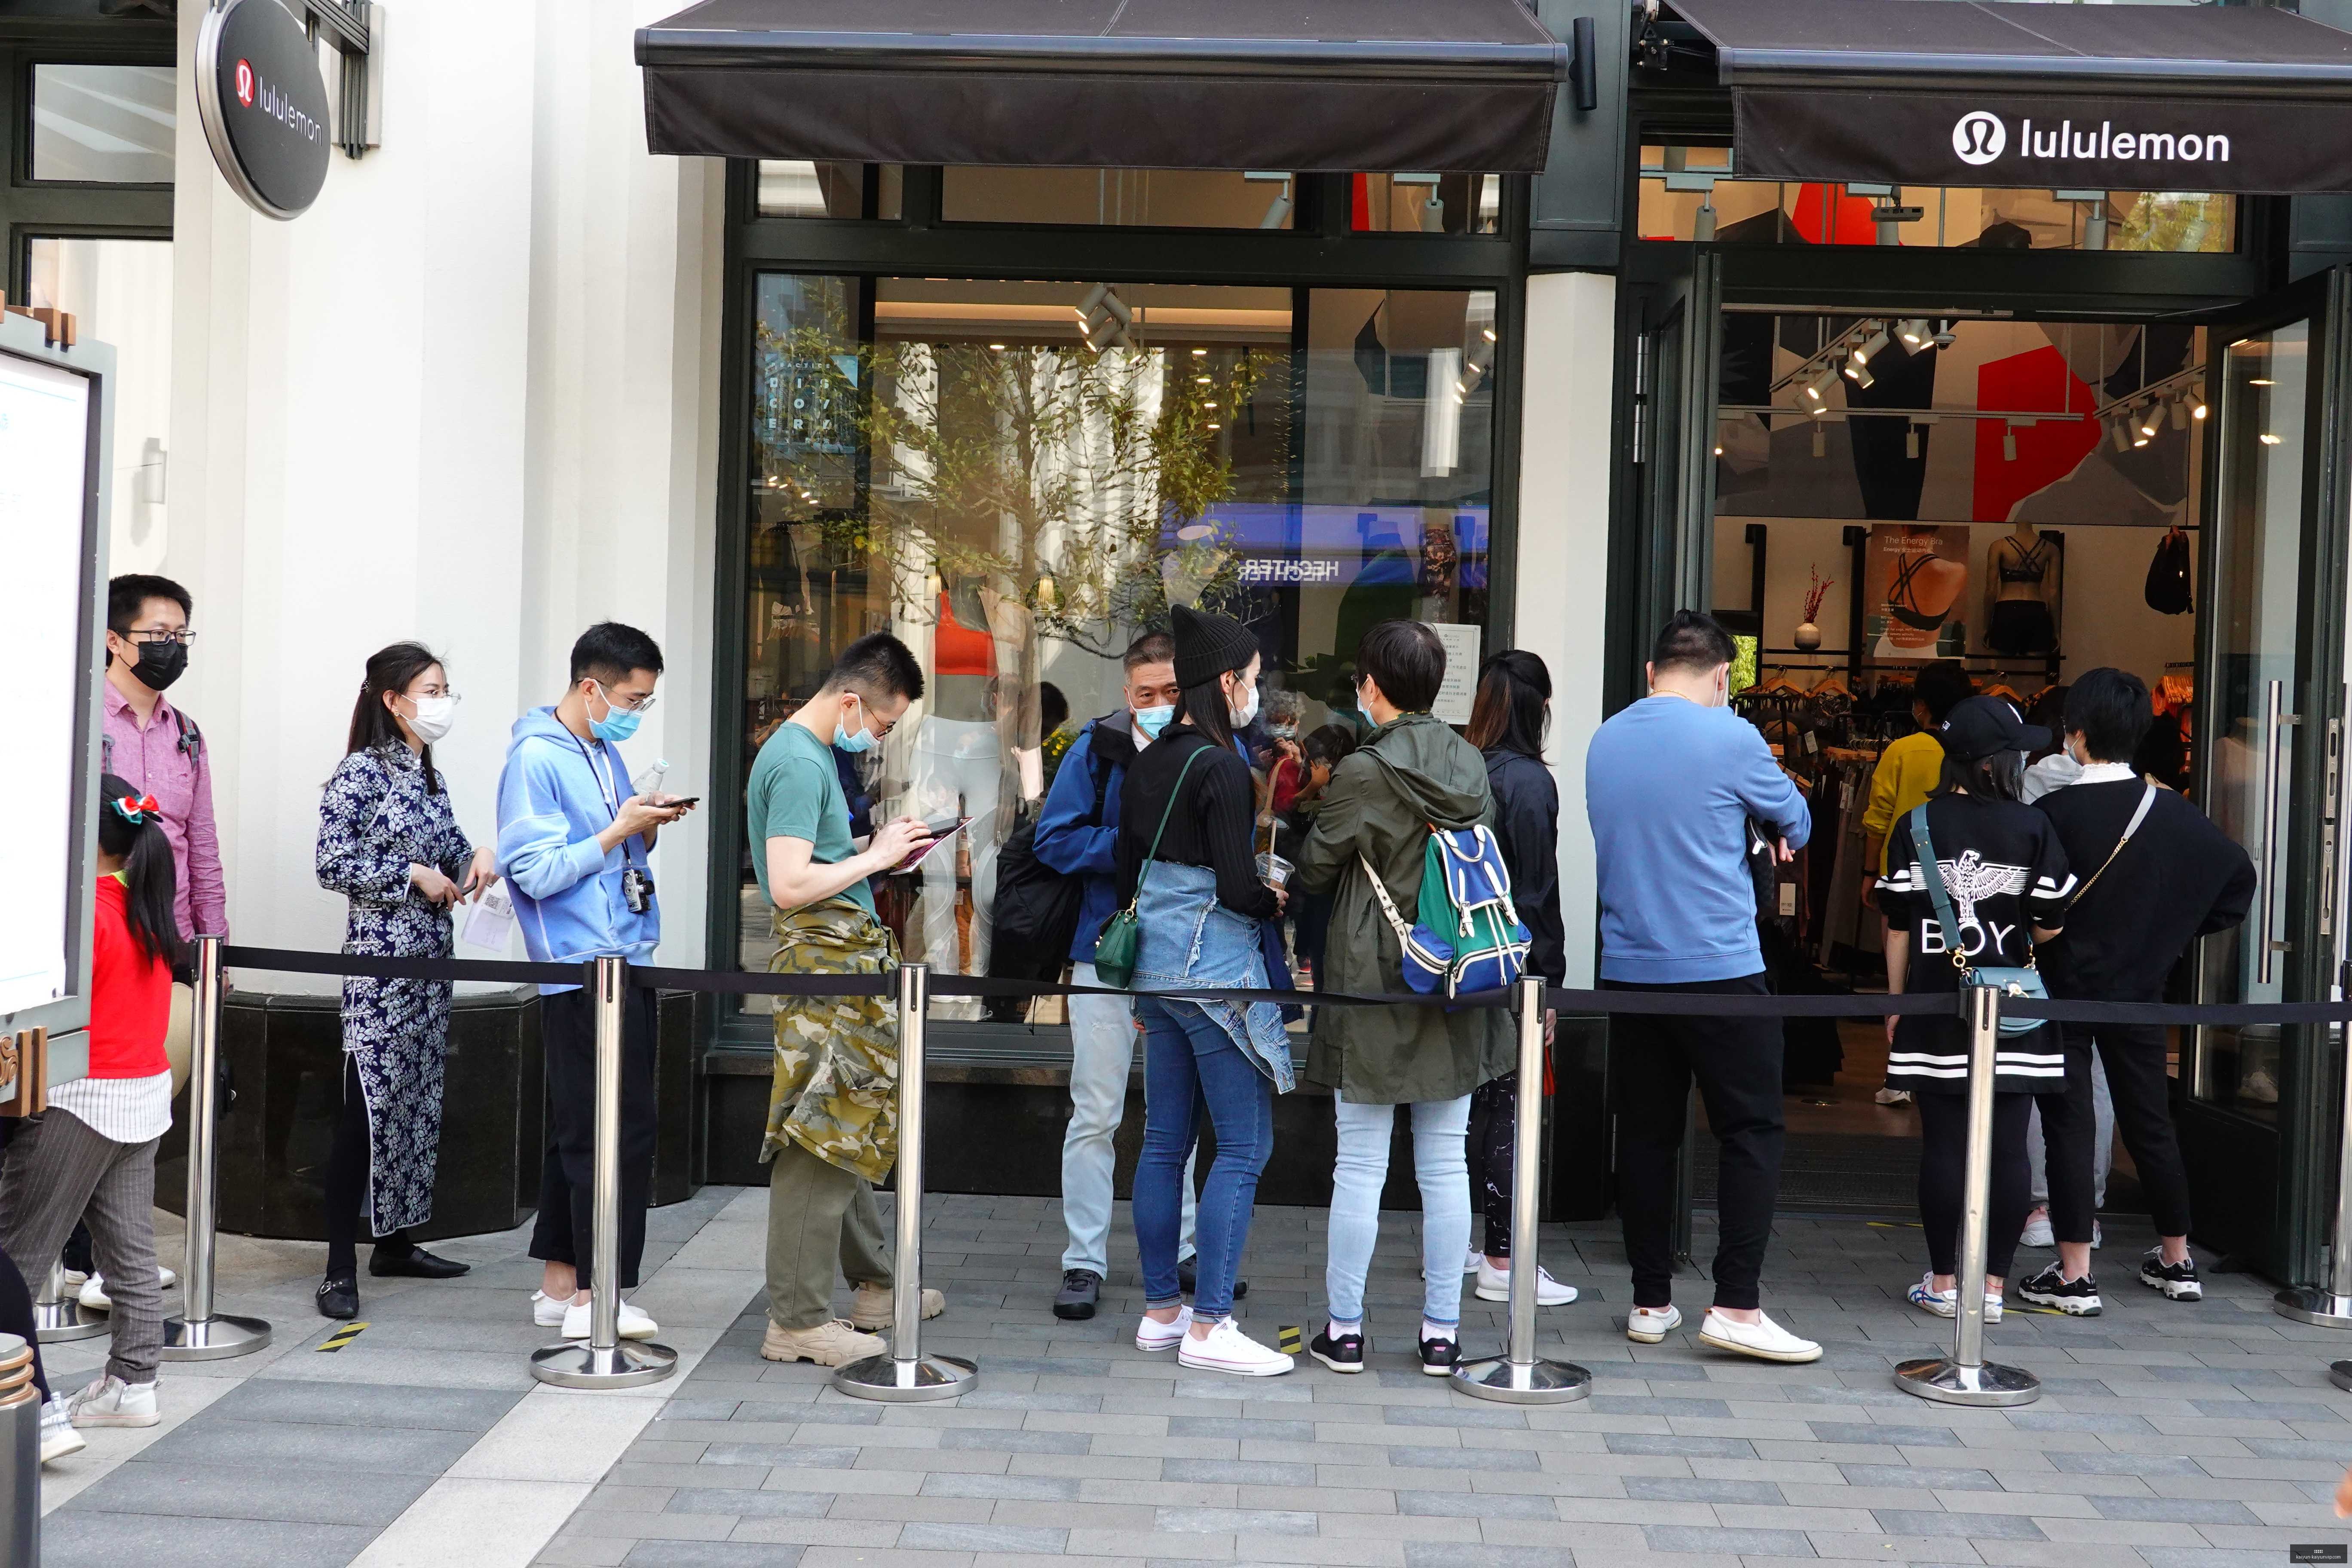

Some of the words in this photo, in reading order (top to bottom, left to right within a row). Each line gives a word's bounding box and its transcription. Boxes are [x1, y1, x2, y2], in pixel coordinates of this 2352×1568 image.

[260, 75, 322, 146] lululemon
[2021, 119, 2229, 162] lululemon
[1884, 536, 1899, 544] The
[1901, 536, 1928, 546] Energy
[1922, 919, 2016, 956] BOY
